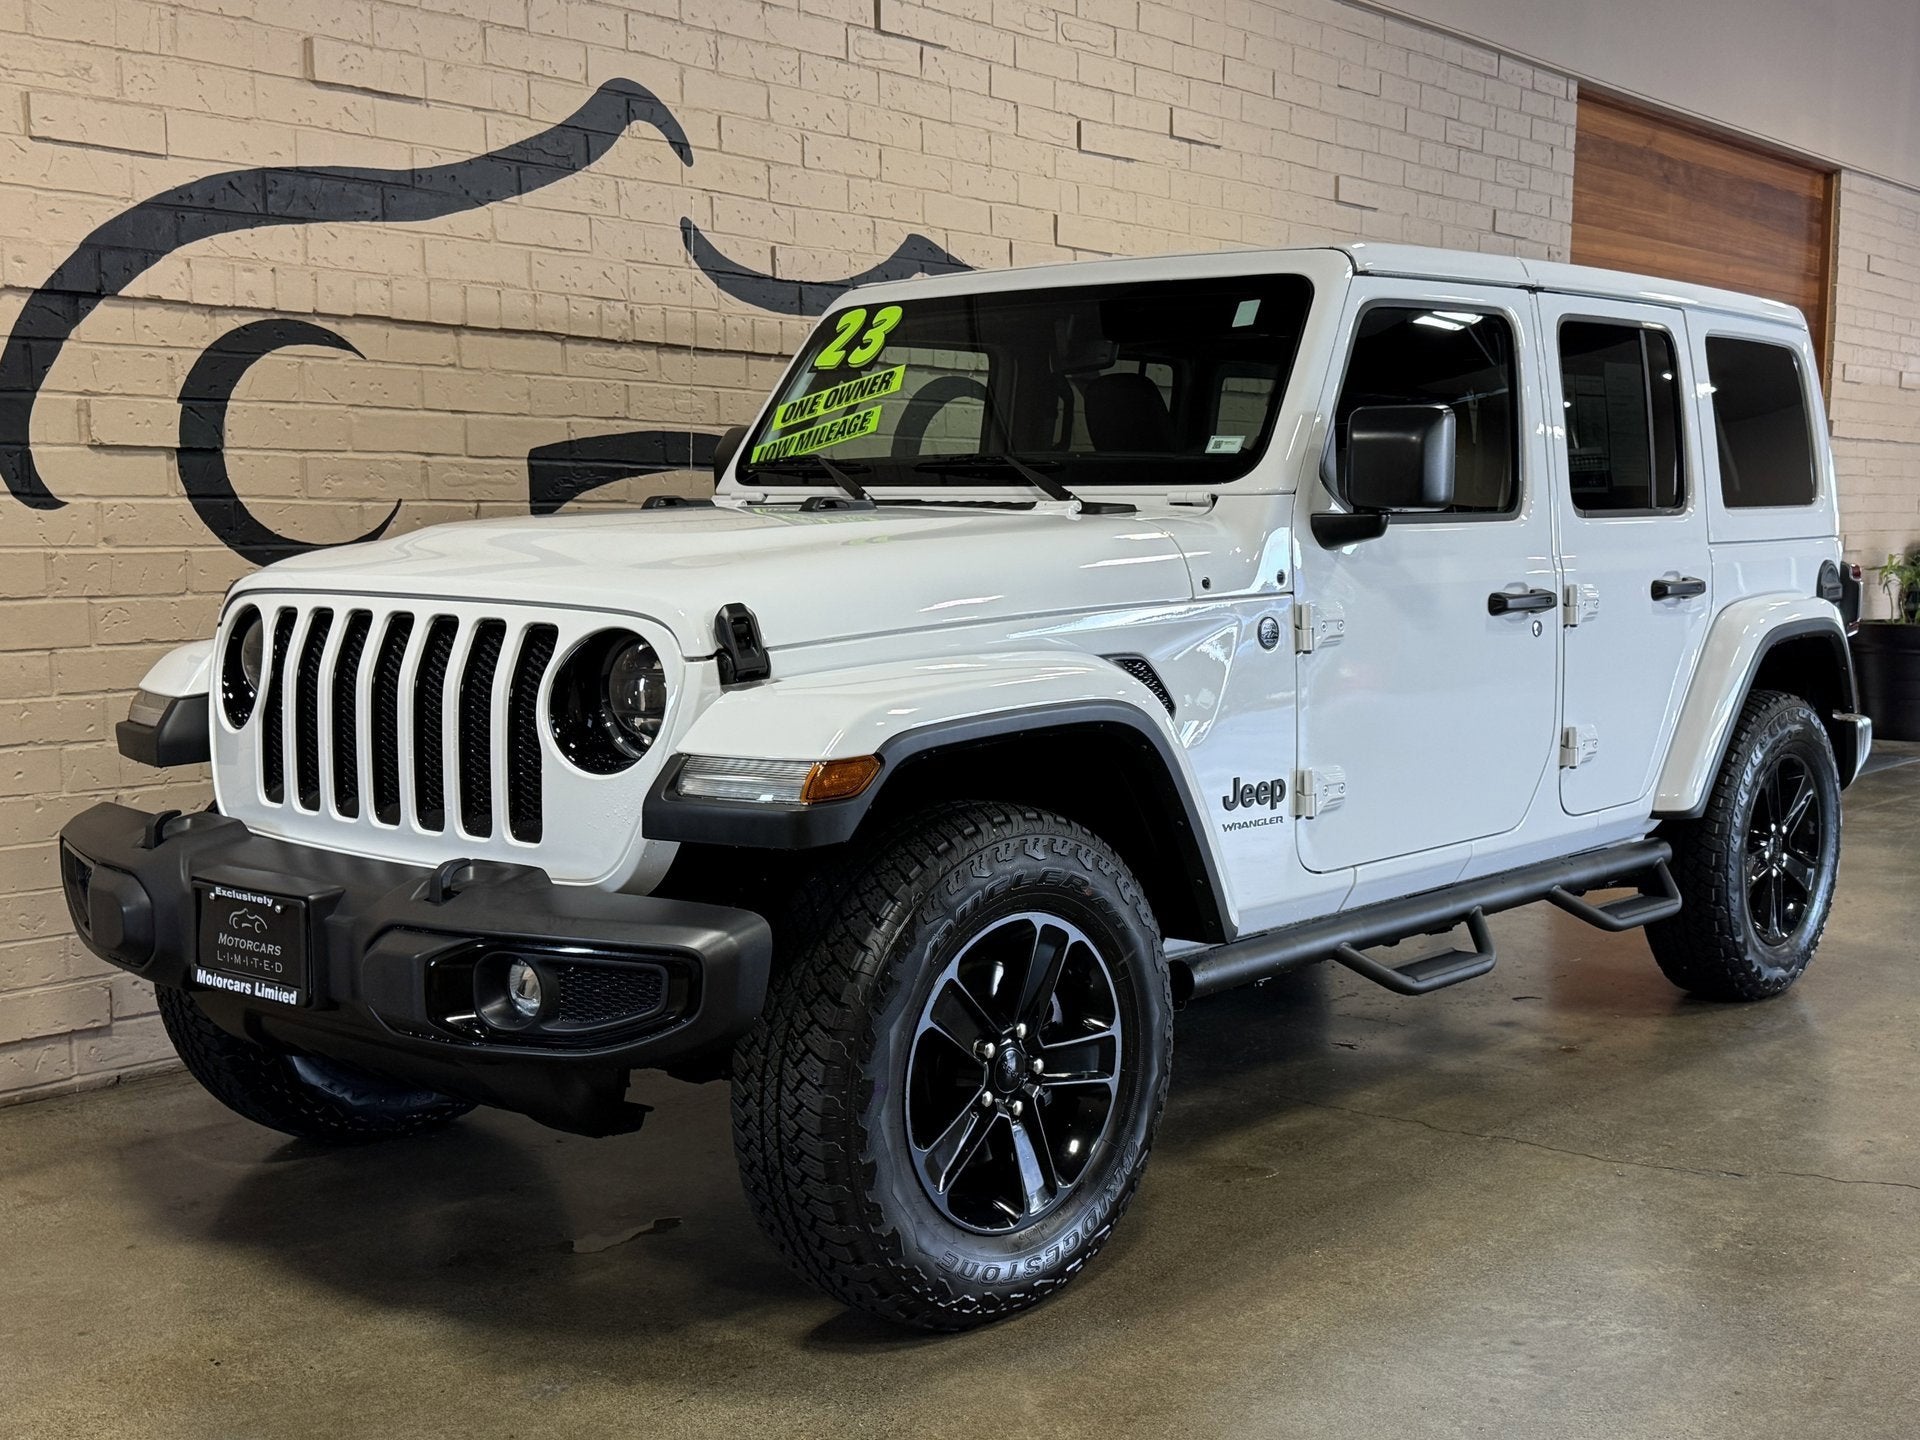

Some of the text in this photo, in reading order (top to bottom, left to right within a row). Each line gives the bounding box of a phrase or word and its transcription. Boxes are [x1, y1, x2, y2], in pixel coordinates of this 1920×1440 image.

[814, 306, 903, 369] 23
[781, 370, 896, 425] ONE OWNER
[758, 410, 874, 464] LOW MILEAGE
[1222, 777, 1286, 811] Jeep
[1222, 816, 1284, 832] WRANGLER
[215, 886, 274, 907] Exclusively
[218, 932, 282, 956] MOTORCARS
[196, 968, 298, 1005] Motorcars Limited
[935, 1135, 1141, 1286] BRIDGESTONE
